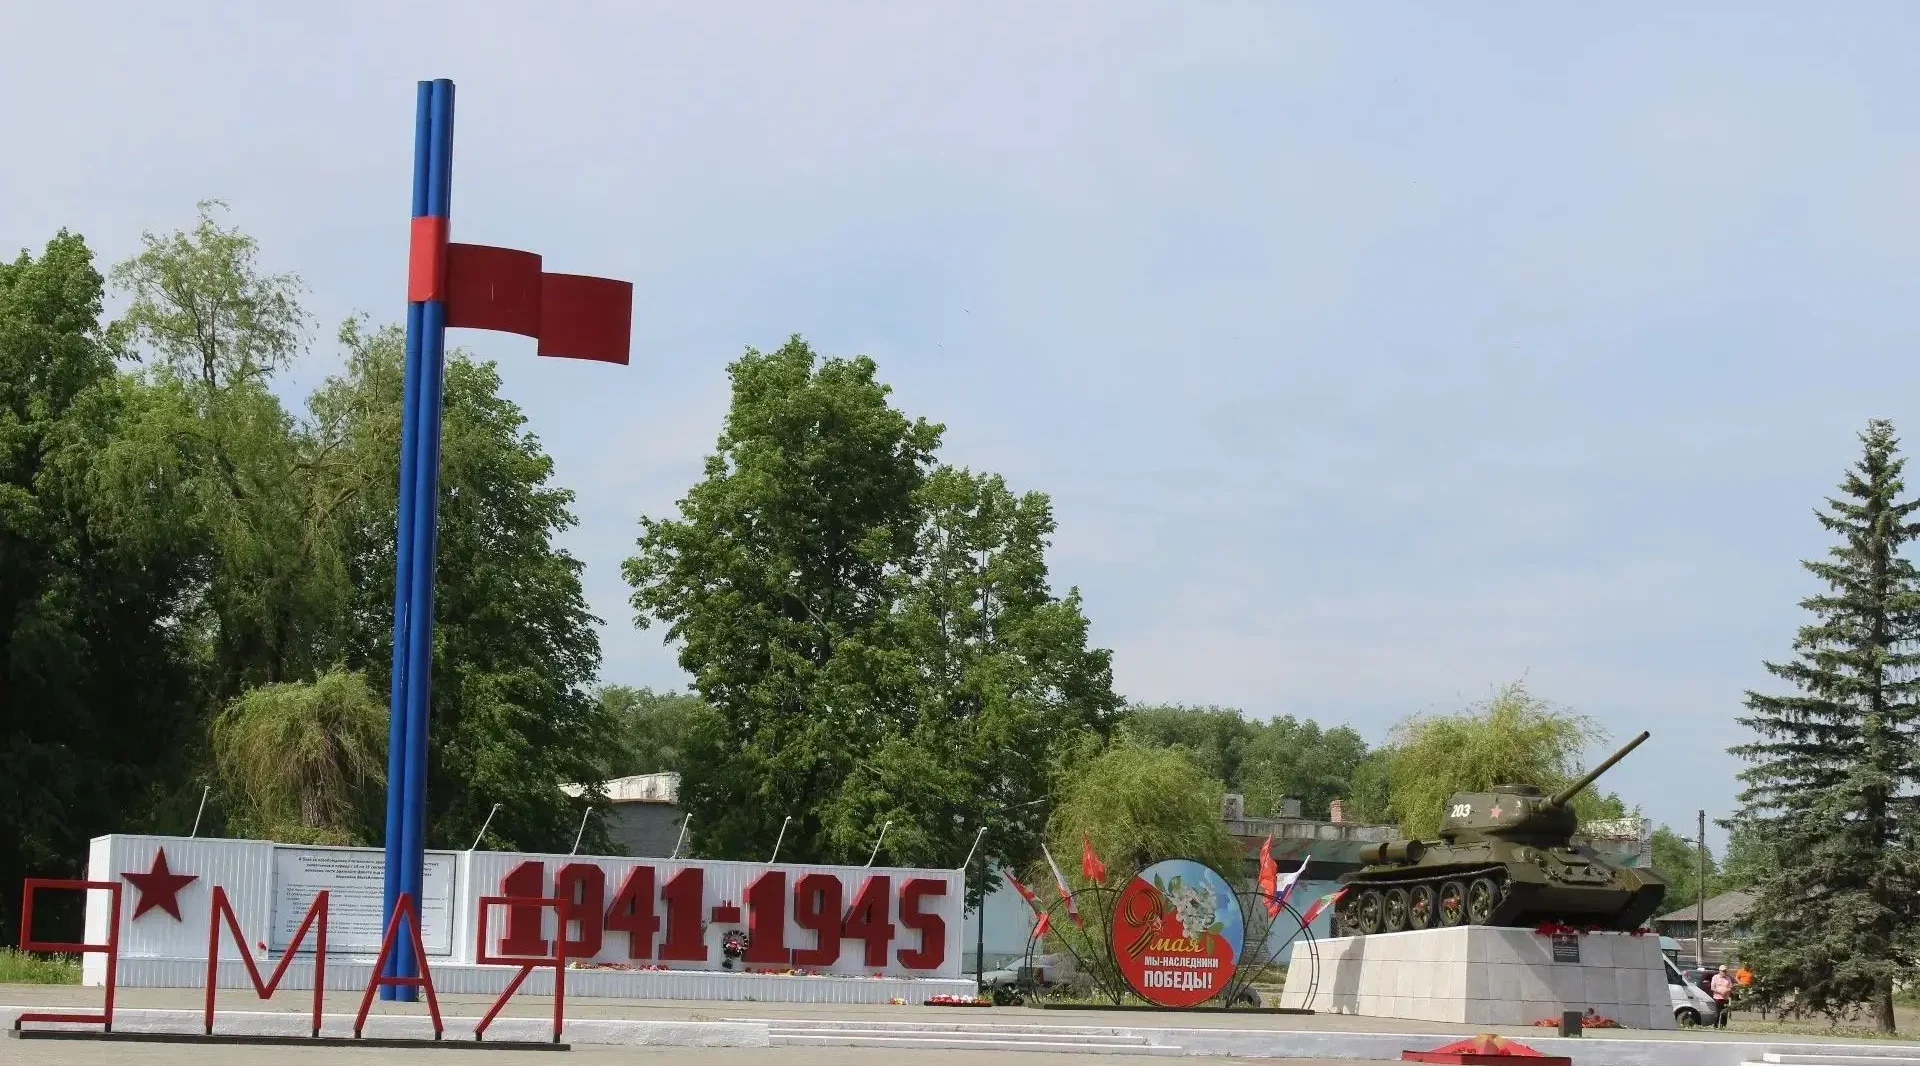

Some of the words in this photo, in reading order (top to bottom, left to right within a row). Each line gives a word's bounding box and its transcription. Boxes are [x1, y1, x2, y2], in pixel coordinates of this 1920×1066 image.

[1451, 803, 1471, 818] 203
[500, 861, 947, 969] 1941-1945
[1124, 888, 1162, 960] 9
[1149, 938, 1204, 953] мая
[16, 878, 122, 1026] 9
[206, 885, 568, 1038] МАЯ
[1144, 955, 1219, 969] МЫ-НАСЛЕДНИКИ
[1144, 970, 1212, 991] ПОБЕДЫ!
